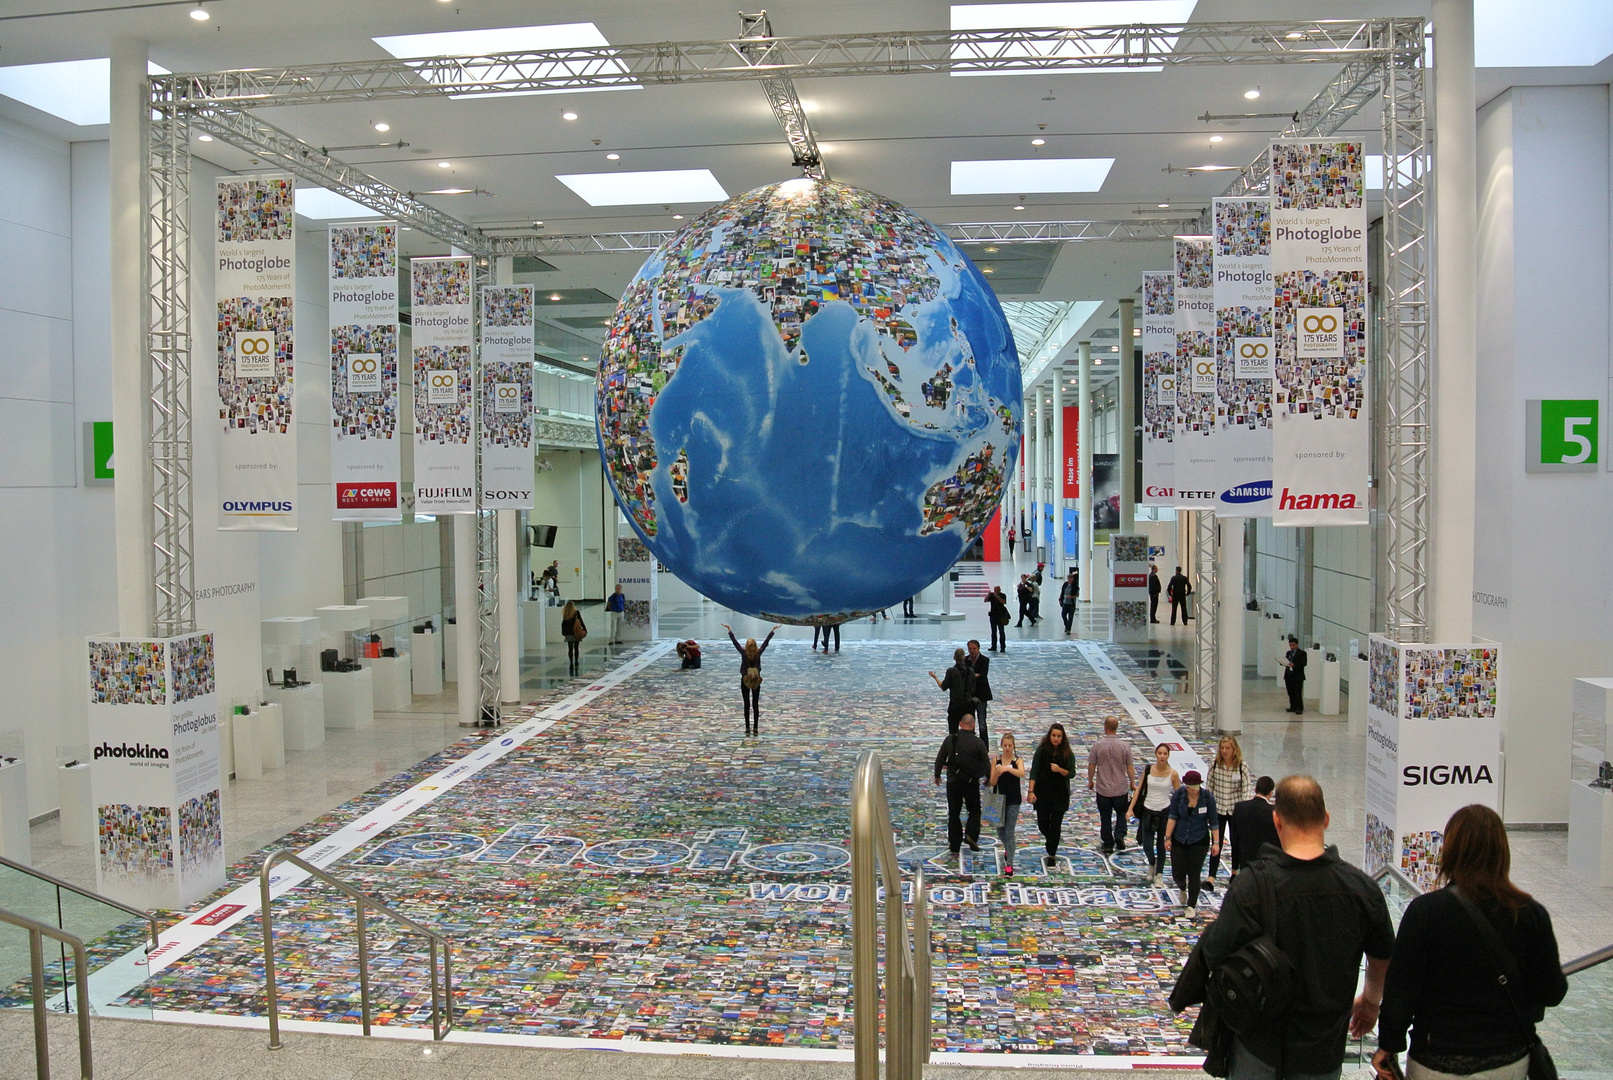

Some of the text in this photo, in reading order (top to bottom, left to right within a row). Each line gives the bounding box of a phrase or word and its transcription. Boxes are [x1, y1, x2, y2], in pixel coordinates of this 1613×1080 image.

[1306, 218, 1330, 226] largest
[1276, 226, 1361, 244] Photoglobe
[244, 248, 264, 257] largest
[220, 256, 290, 272] Photoglobe
[332, 290, 394, 304] Photoglobe
[415, 316, 469, 328] Photoglobe
[1146, 326, 1174, 335] Photo
[484, 336, 532, 346] Photoglobe
[1316, 334, 1337, 342] YEARS
[1561, 417, 1592, 464] 5
[1295, 451, 1347, 459] sponsored by:
[1067, 458, 1074, 467] im
[360, 488, 391, 497] cewe
[418, 488, 472, 498] FUJIFILM
[485, 491, 531, 500] SONY
[1279, 488, 1356, 510] hama
[223, 501, 292, 511] OLYMPUS
[212, 582, 256, 598] PHOTOGRAPHY
[174, 713, 216, 735] Photoglobus
[94, 742, 169, 760] photokina
[1403, 765, 1493, 786] SIGMA
[930, 882, 990, 905] of
